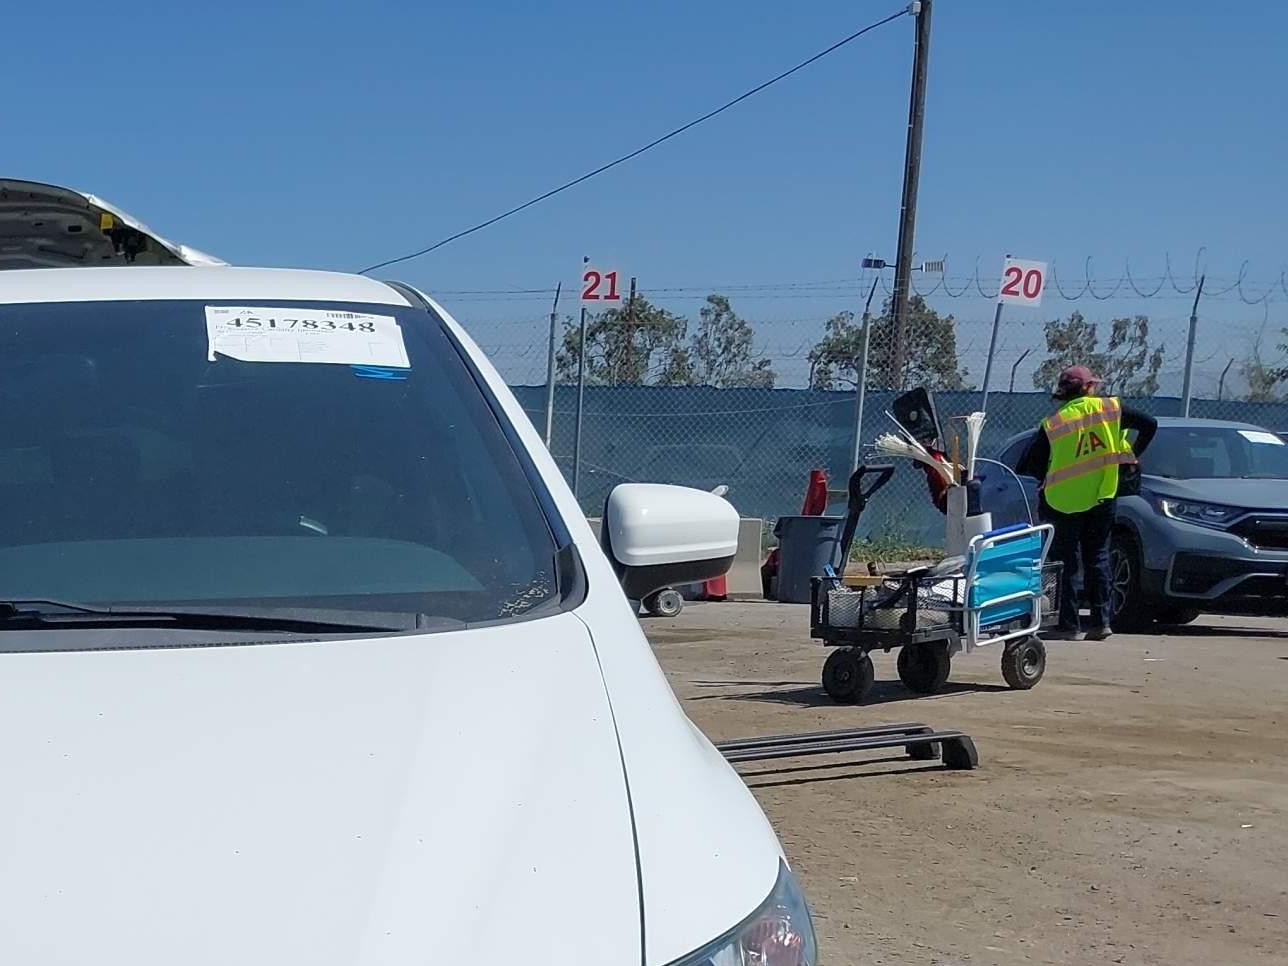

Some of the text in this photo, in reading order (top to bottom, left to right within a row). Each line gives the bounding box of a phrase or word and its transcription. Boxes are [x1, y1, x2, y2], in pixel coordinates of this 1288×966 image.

[582, 271, 620, 300] 21
[1001, 266, 1042, 299] 20
[225, 317, 376, 333] 45178348
